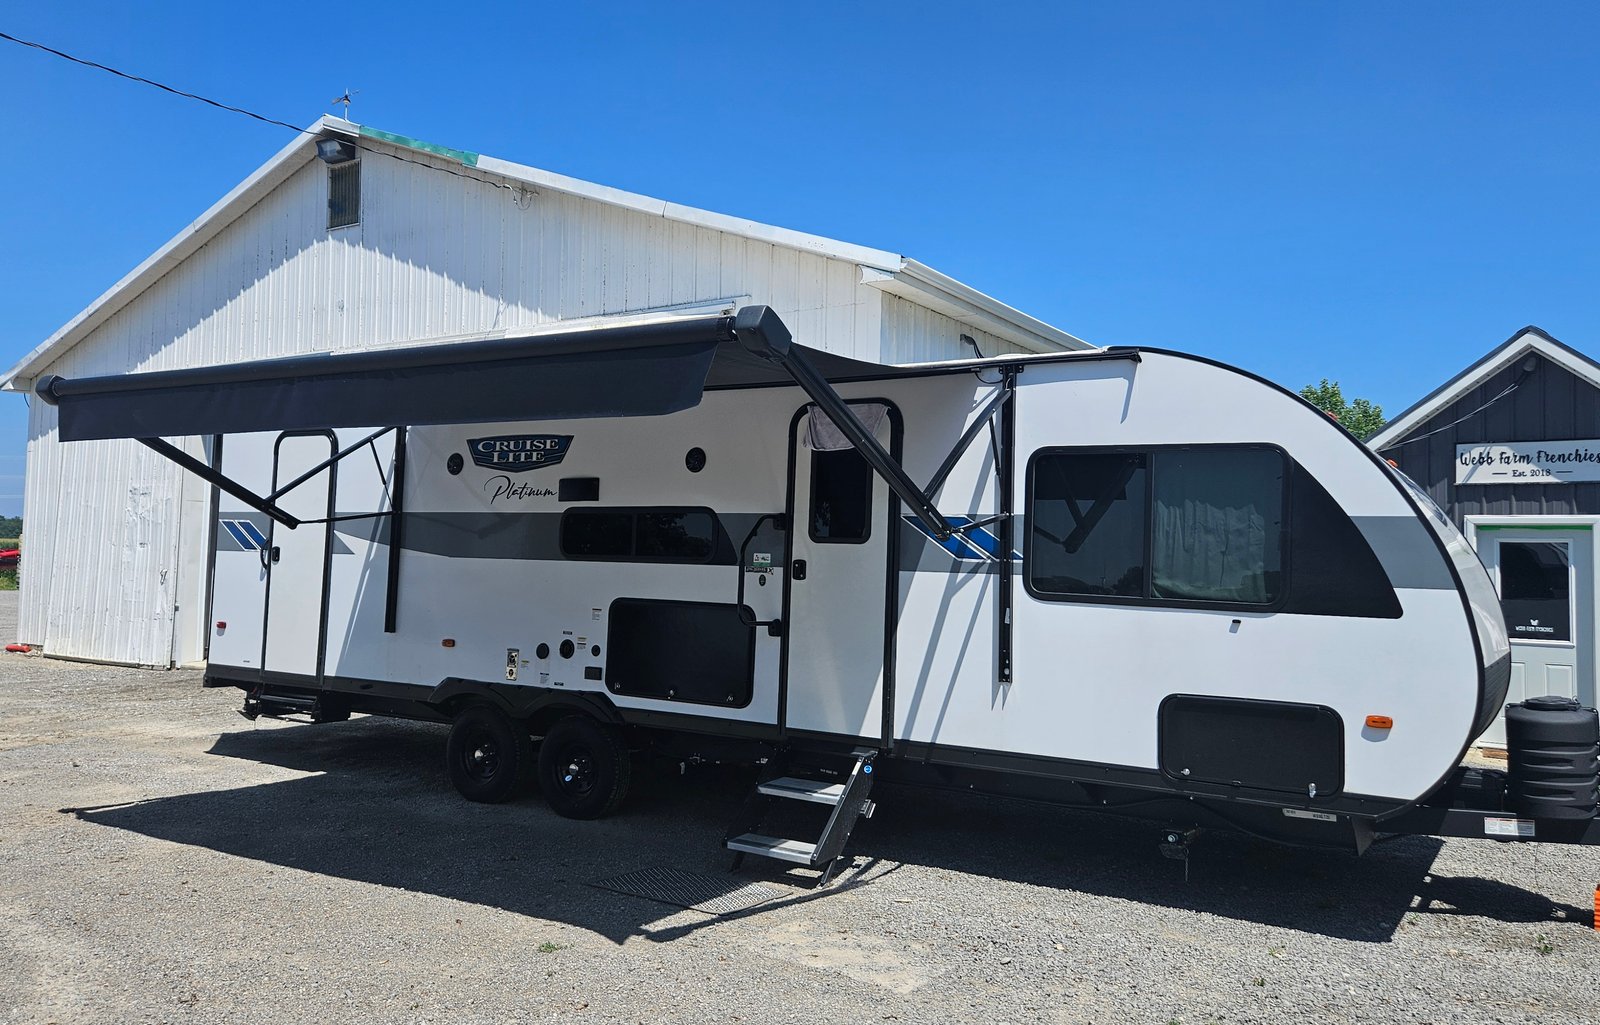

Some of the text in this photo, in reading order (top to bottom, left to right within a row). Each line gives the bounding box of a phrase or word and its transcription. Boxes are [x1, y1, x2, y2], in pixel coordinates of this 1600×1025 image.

[477, 439, 559, 452] CRUISE
[492, 451, 546, 463] LITE
[1460, 449, 1600, 466] Webb Farm Frenchies
[1530, 469, 1551, 477] 2018
[484, 475, 558, 504] Platinum
